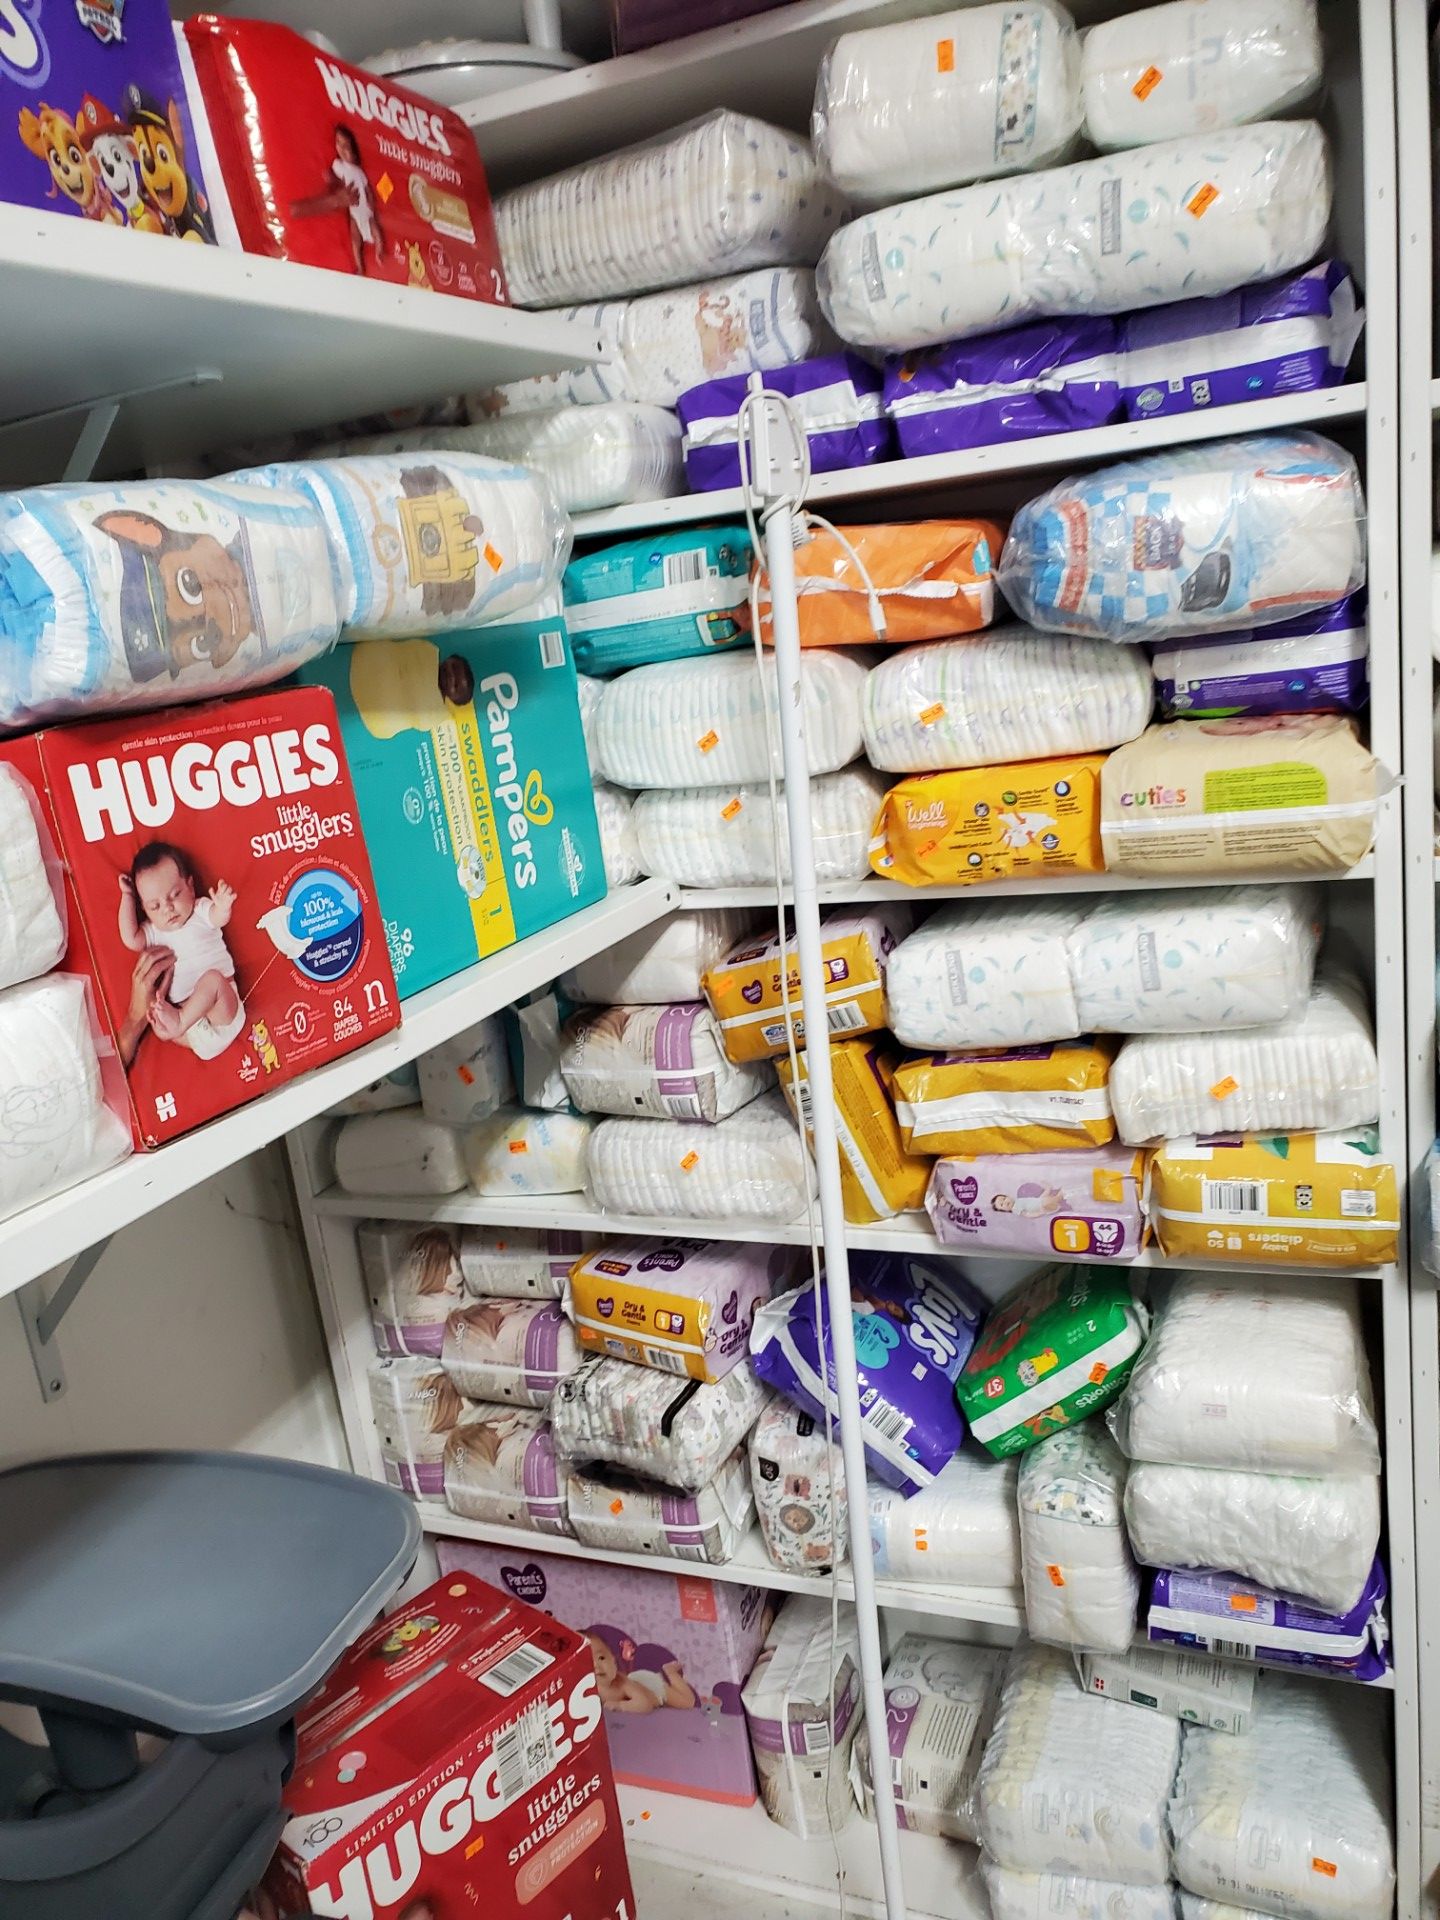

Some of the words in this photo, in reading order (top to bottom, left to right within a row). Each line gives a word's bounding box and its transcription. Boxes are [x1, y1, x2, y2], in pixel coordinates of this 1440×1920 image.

[315, 57, 452, 156] HUGGIES
[490, 268, 505, 303] 2
[436, 726, 449, 760] skin
[421, 742, 436, 793] protection
[67, 723, 339, 843] HUGGIES
[423, 777, 432, 801] 100
[480, 671, 536, 889] Pampers
[433, 794, 440, 808] de
[461, 722, 494, 862] swaddlers
[1120, 785, 1187, 808] cuties
[276, 800, 312, 827] little
[442, 761, 463, 846] protection
[435, 810, 442, 821] la
[250, 812, 353, 858] snugglers
[438, 822, 448, 855] peau
[304, 896, 335, 916] 100%
[489, 904, 503, 917] 1
[387, 920, 407, 974] DIAPERS
[401, 927, 415, 958] 96
[363, 980, 389, 1013] n
[333, 996, 353, 1019] 84
[333, 1022, 363, 1042] COUCHES
[334, 1014, 359, 1031] DIAPERS
[949, 1214, 987, 1228] Gentle
[973, 1207, 982, 1217] &
[1099, 1223, 1112, 1231] 44
[1065, 1230, 1078, 1249] 1
[1207, 1238, 1225, 1249] 50
[1248, 1231, 1303, 1246] diapers
[1261, 1242, 1290, 1253] baby
[621, 1310, 646, 1322] Gentle
[624, 1301, 638, 1312] Dry
[640, 1304, 645, 1312] &
[721, 1325, 739, 1342] Dry
[1086, 1319, 1097, 1332] 2
[987, 1379, 1003, 1397] 37
[506, 1573, 543, 1589] Parent's
[517, 1584, 543, 1595] CHOICE
[345, 1804, 405, 1858] LIMITED
[408, 1756, 465, 1807] EDITION
[526, 1774, 576, 1825] little
[507, 1774, 601, 1866] snugglers
